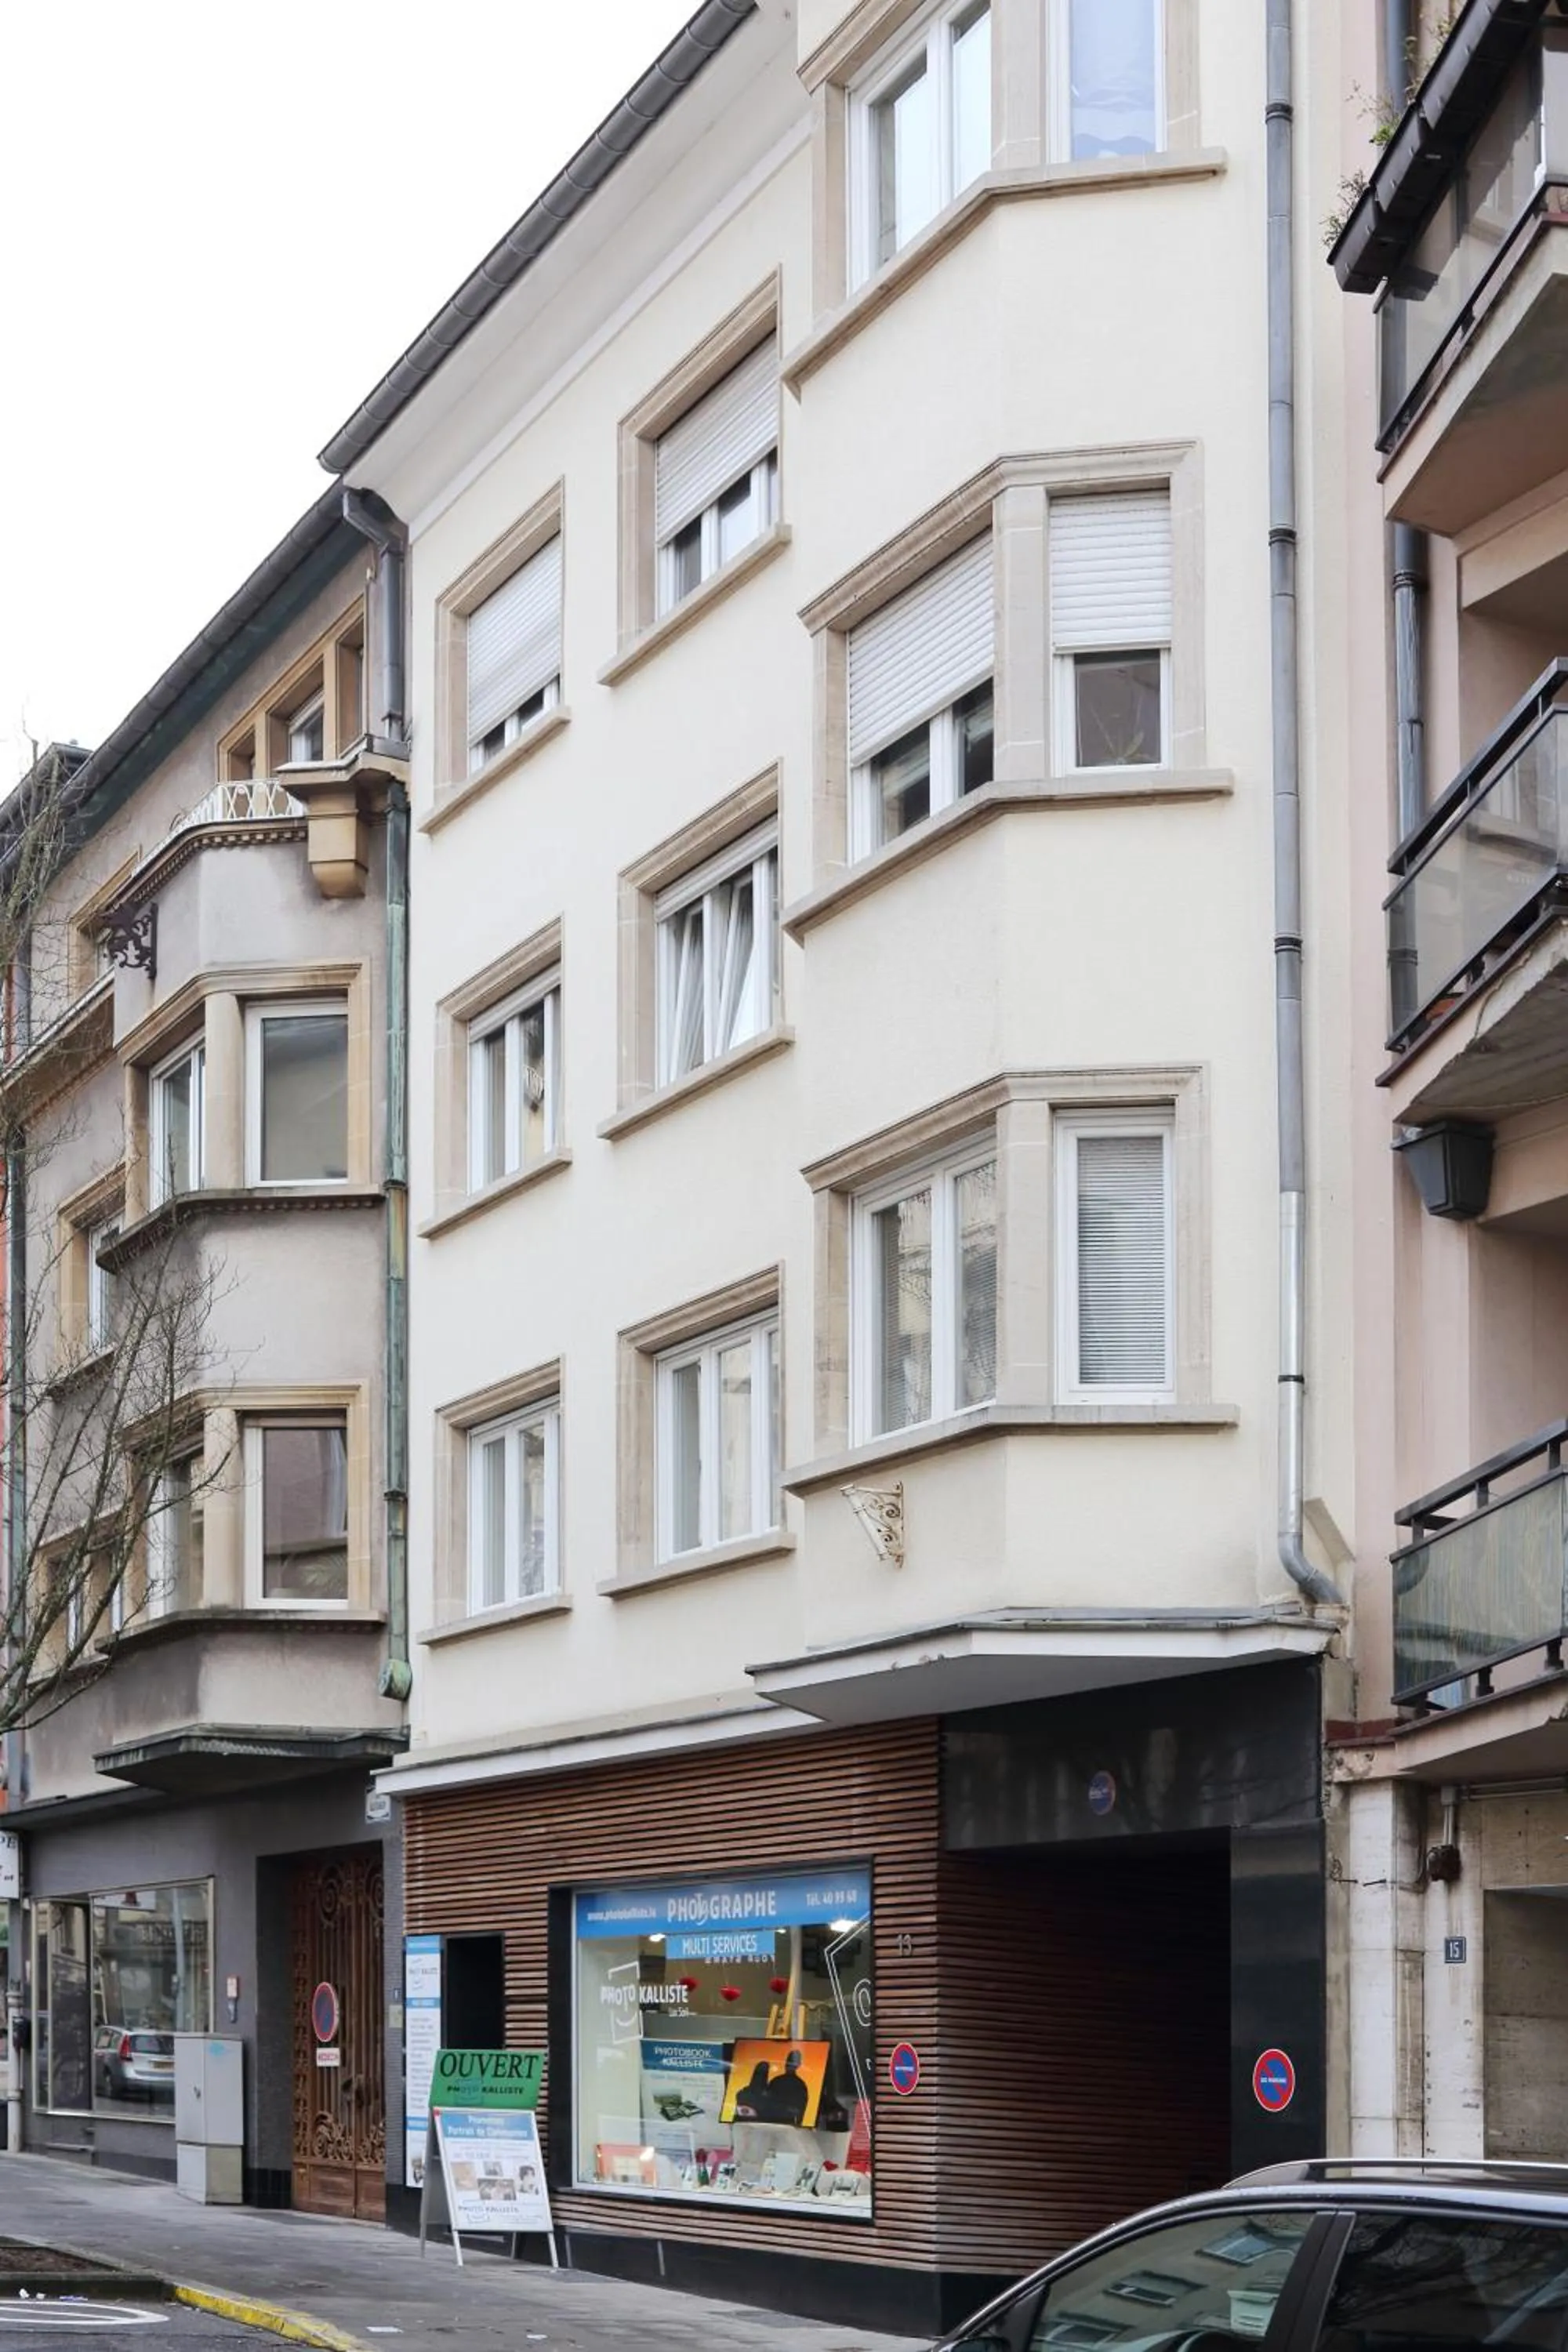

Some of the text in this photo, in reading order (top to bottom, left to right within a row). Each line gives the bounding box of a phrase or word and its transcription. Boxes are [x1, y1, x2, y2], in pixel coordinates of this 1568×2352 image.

[682, 1933, 757, 1956] MULTI SERVICES
[1450, 1941, 1460, 1958] 15
[601, 1984, 688, 2011] PHOTO KALLISTE
[654, 2046, 712, 2058] PHOTOBOOK
[440, 2052, 539, 2078] OUVERT
[481, 2085, 524, 2095] KALLISTE
